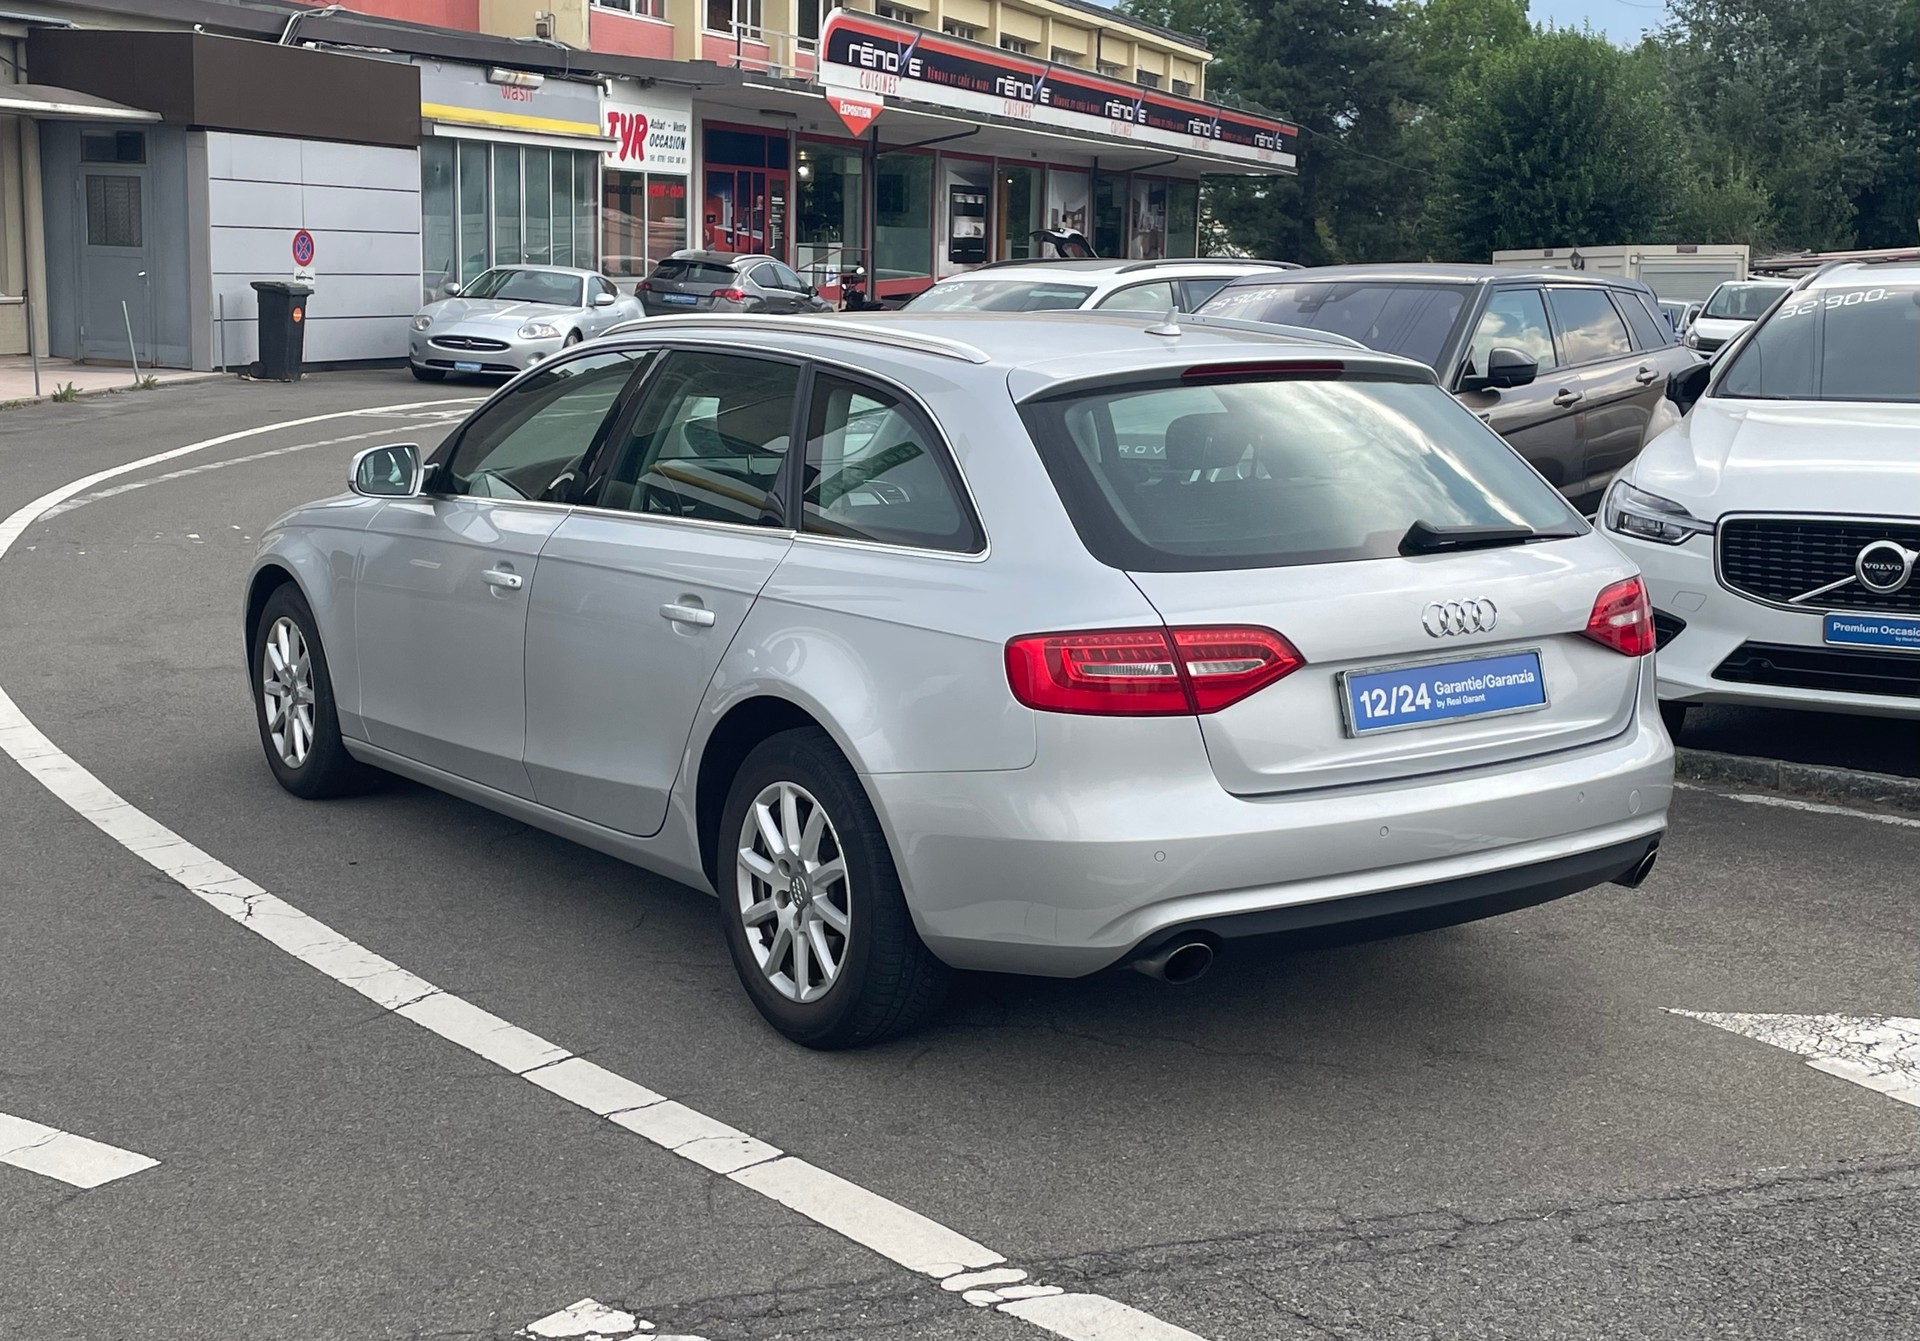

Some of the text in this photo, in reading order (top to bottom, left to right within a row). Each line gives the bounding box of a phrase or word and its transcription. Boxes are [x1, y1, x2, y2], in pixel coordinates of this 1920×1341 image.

[860, 70, 897, 94] CUISINES
[1003, 100, 1032, 118] CUISINES
[649, 118, 666, 131] Achat
[607, 111, 648, 162] TYR
[649, 133, 687, 151] OCCASION
[1863, 562, 1902, 571] VOLVO
[1833, 621, 1878, 634] Premium
[1359, 669, 1535, 718] 12/24 Garantie/Garanzia
[1436, 693, 1486, 709] by Real Garant
